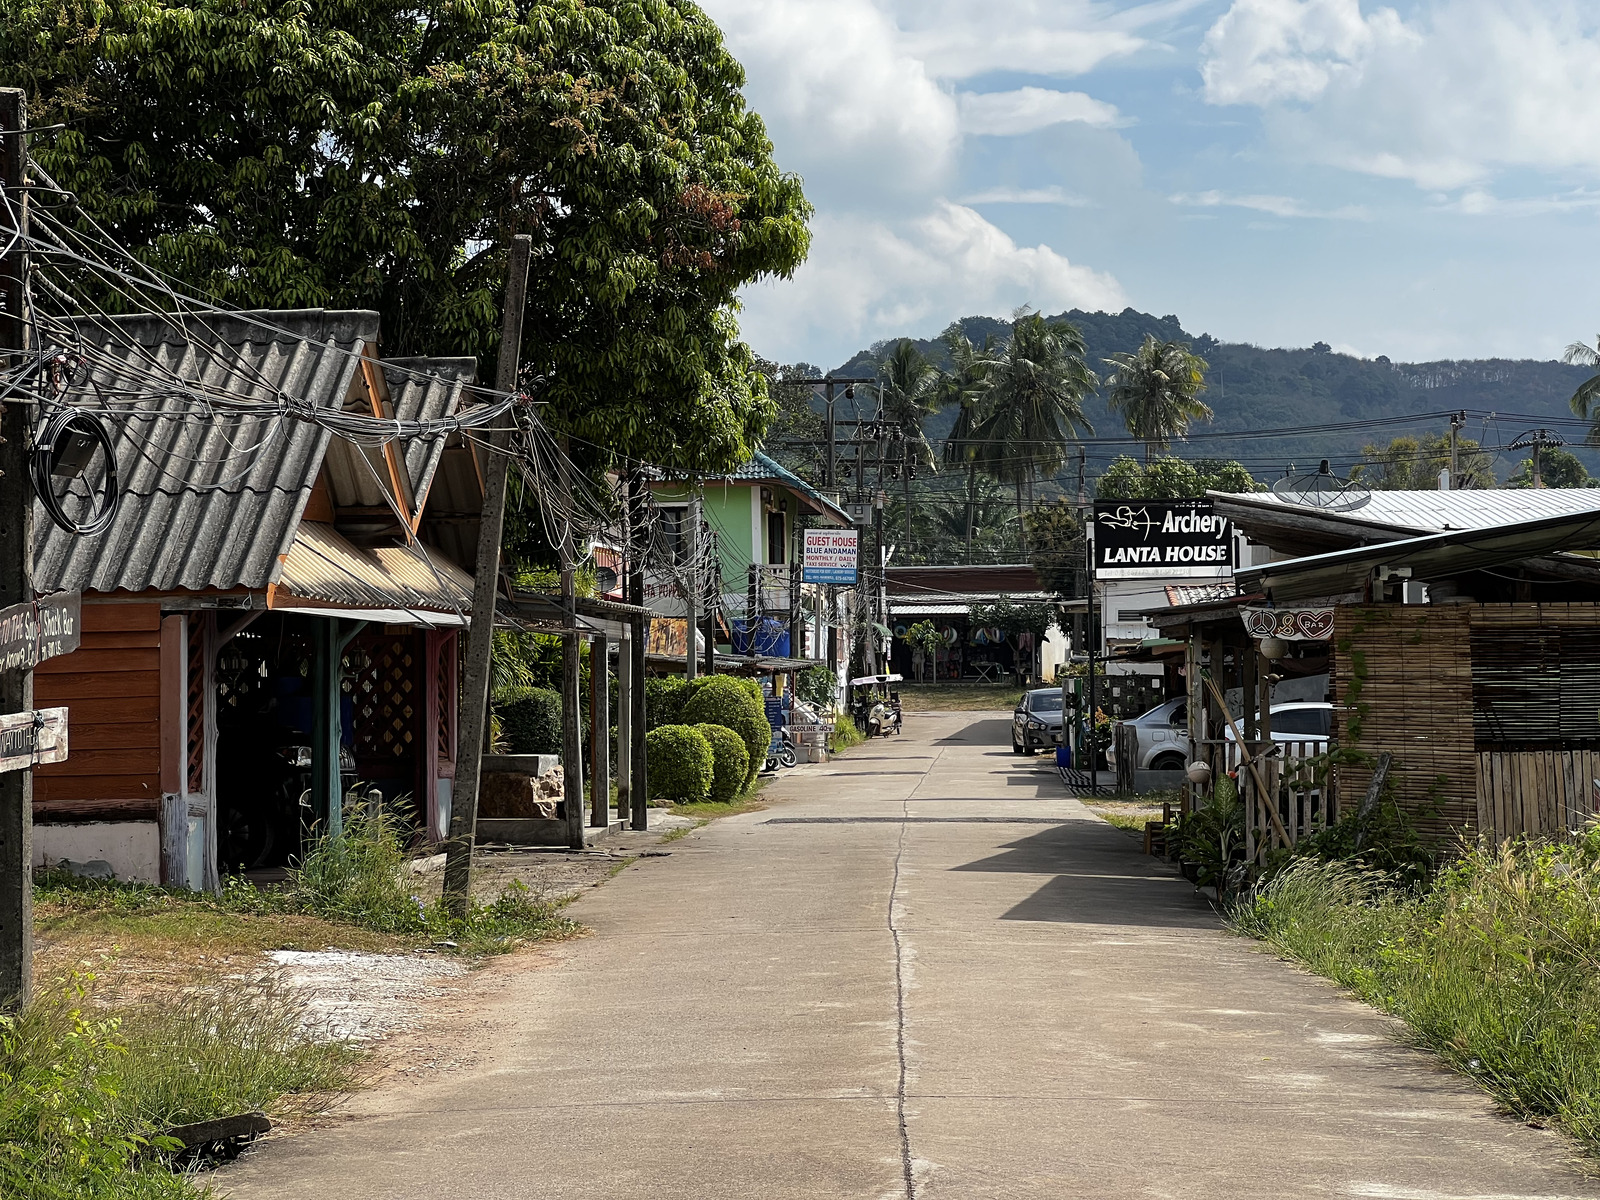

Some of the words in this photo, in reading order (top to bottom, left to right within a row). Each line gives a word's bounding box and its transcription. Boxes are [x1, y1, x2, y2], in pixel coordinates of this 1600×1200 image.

[1161, 509, 1227, 539] Archery
[807, 536, 830, 546] GUEST
[832, 538, 856, 547] HOUSE
[1103, 547, 1161, 563] LANTA
[1165, 545, 1227, 562] HOUSE
[1304, 620, 1324, 629] BAR
